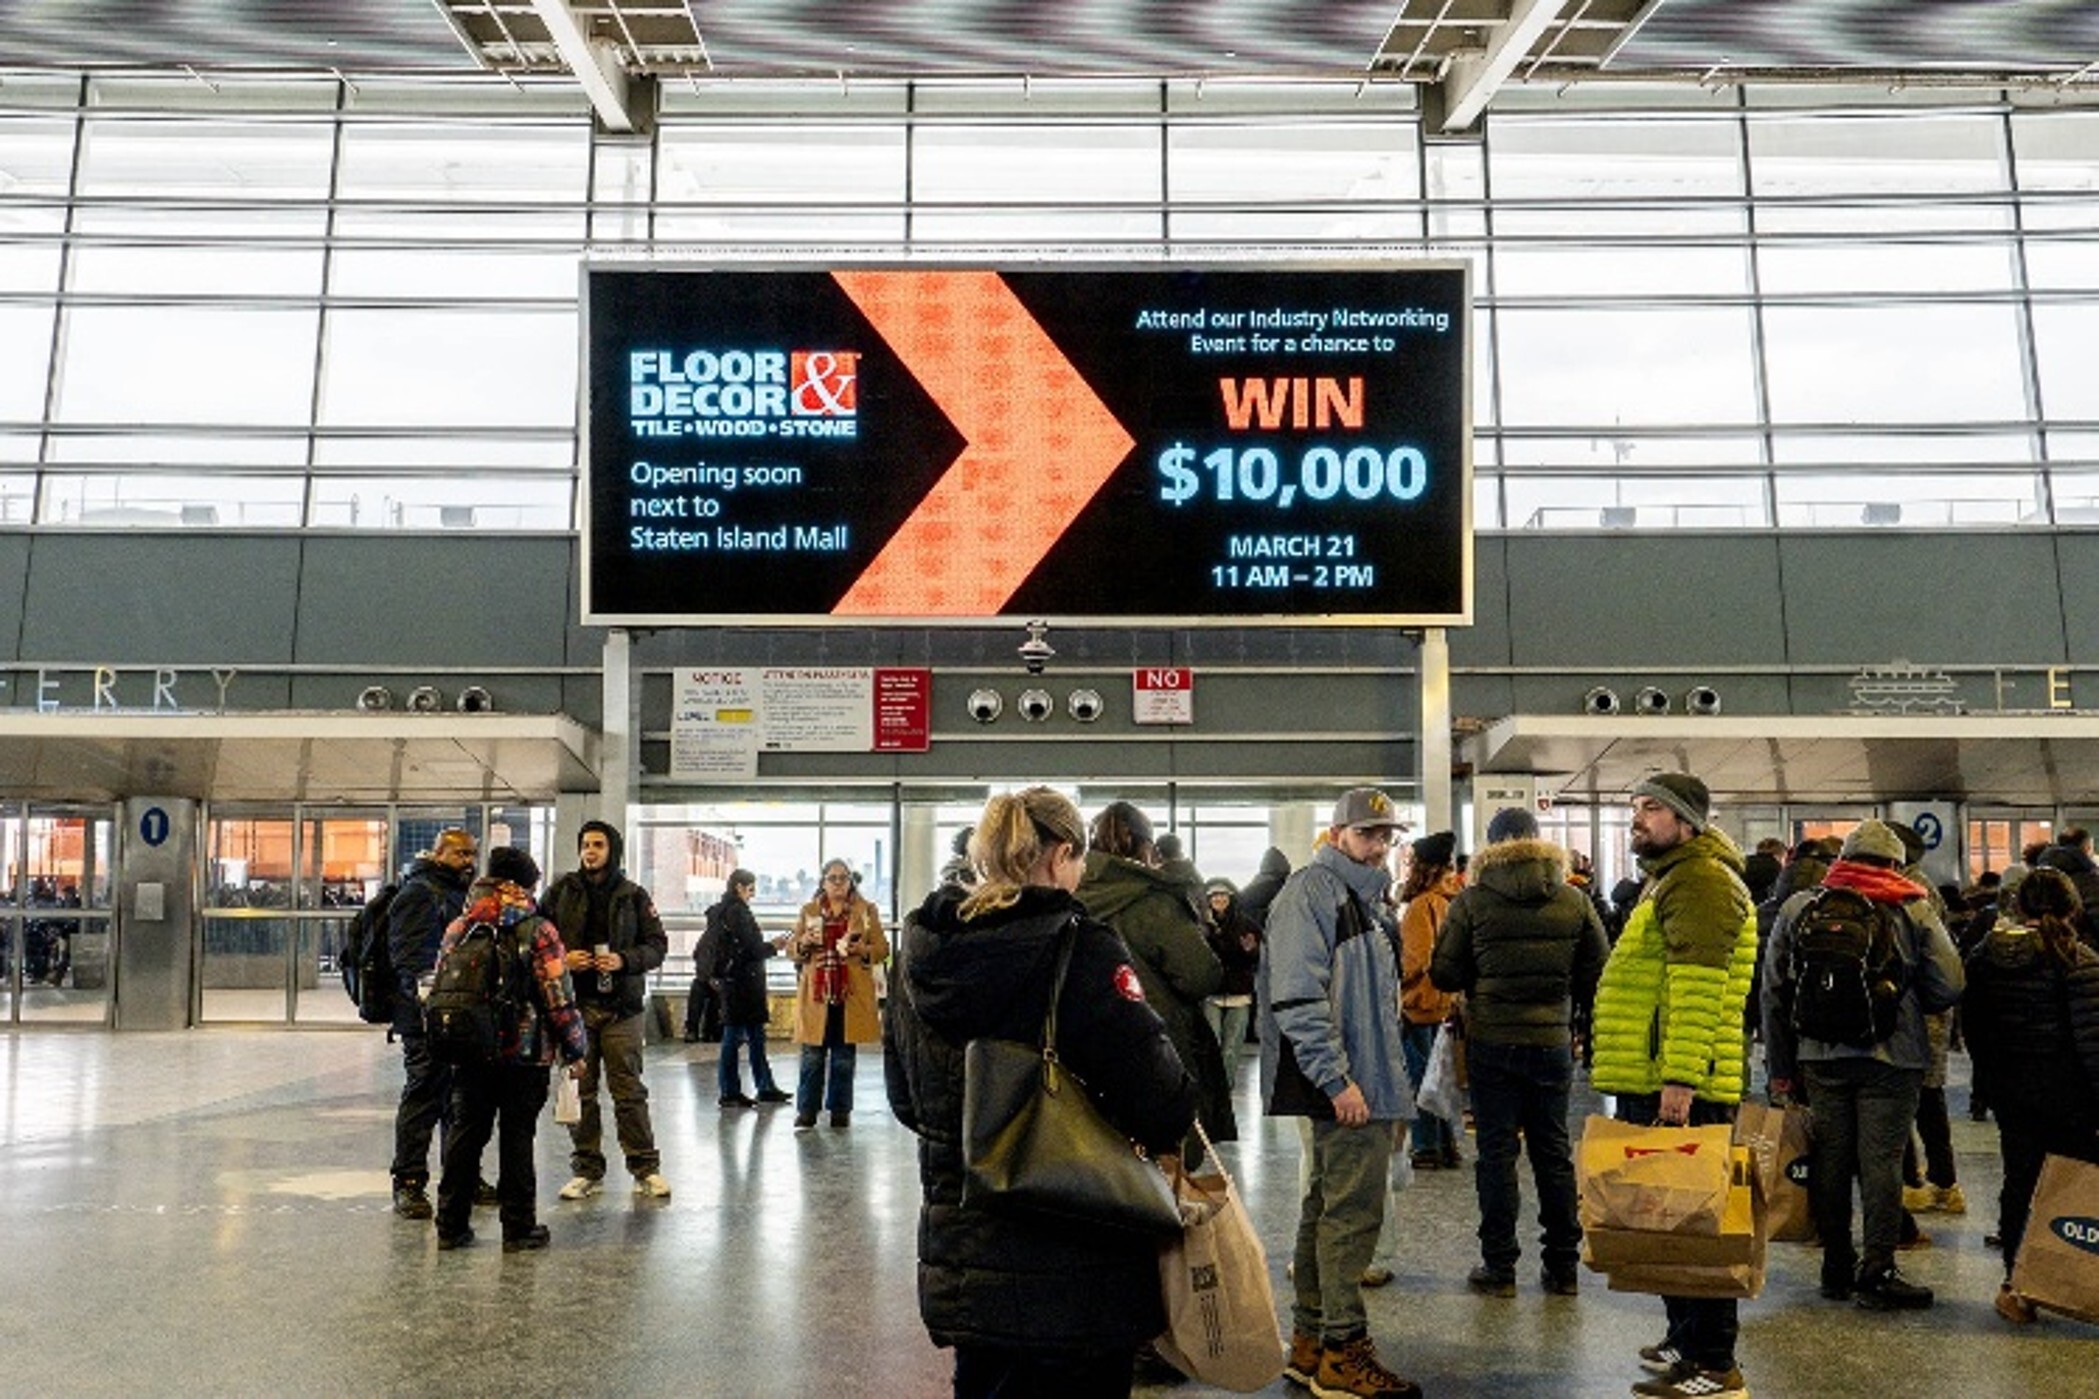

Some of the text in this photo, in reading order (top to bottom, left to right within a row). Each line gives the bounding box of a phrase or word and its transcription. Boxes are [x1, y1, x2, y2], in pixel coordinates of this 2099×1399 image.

[1136, 308, 1450, 331] Attend our Industry Networking
[1191, 333, 1396, 352] Event for a chance to
[630, 351, 857, 416] FLOOR &
[630, 385, 787, 416] DECOR
[1219, 377, 1364, 429] WIN
[631, 462, 801, 490] Opening soon
[1158, 442, 1427, 508] $10,000
[631, 496, 719, 517] next to
[631, 526, 847, 550] Staten Island Mall
[1231, 535, 1354, 557] MARCH 21
[1212, 565, 1239, 587] 11
[1245, 565, 1289, 587] AM
[1314, 565, 1328, 587] 2
[1335, 565, 1374, 587] PM
[0, 667, 236, 713] ERRY
[1146, 670, 1180, 688] NO
[149, 814, 160, 840] 1
[1918, 818, 1937, 845] 2
[2062, 1221, 2099, 1244] OLD
